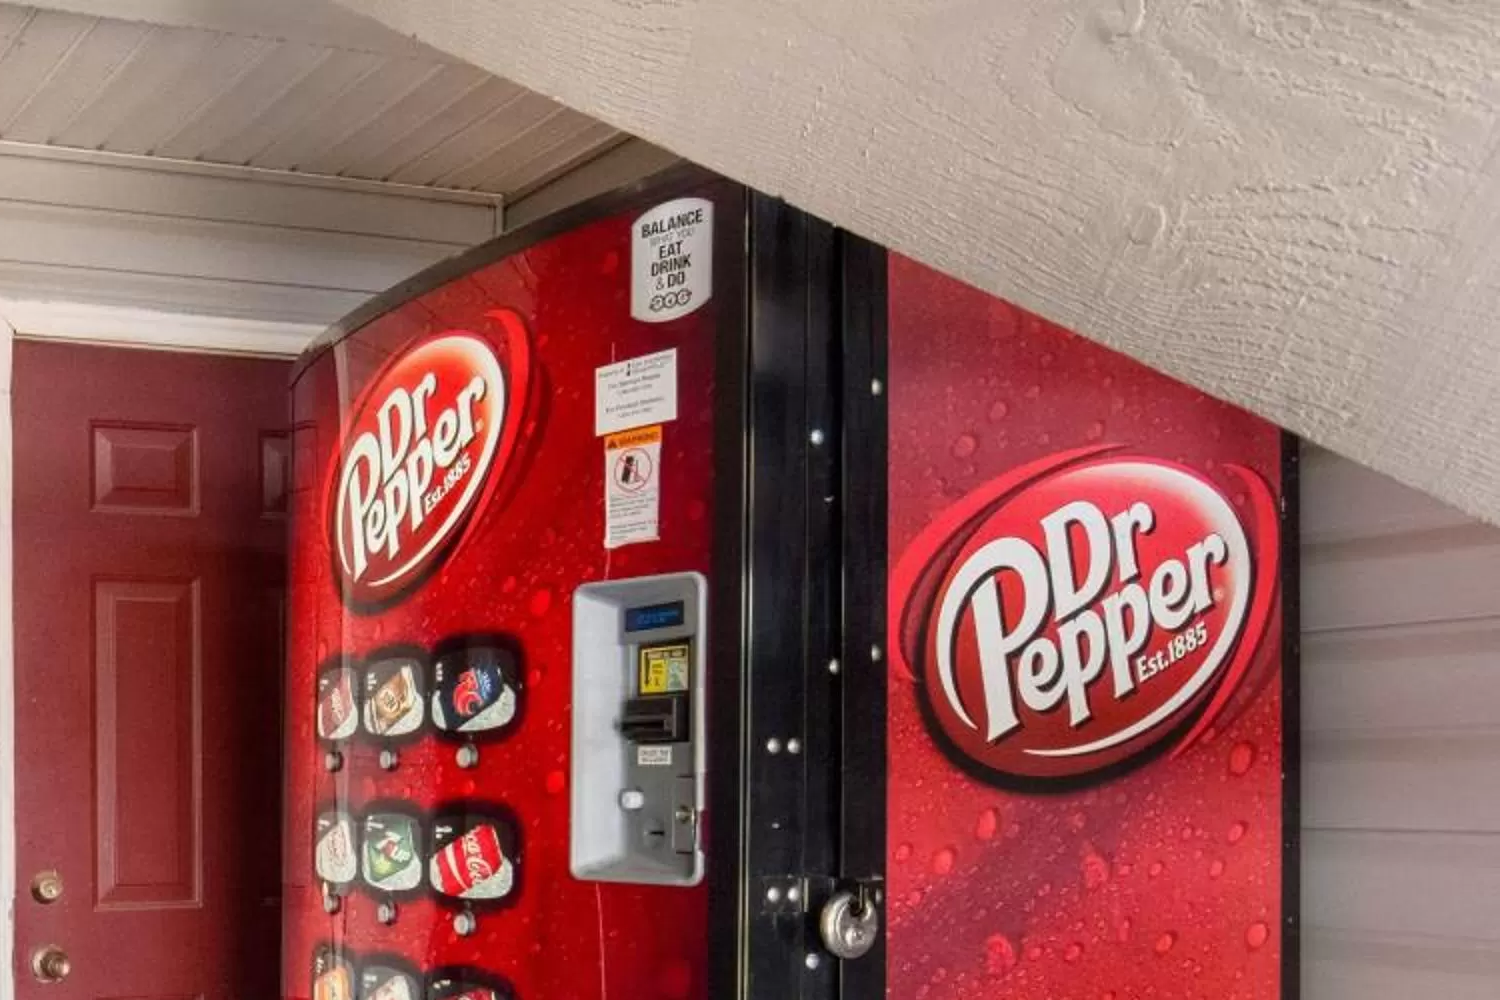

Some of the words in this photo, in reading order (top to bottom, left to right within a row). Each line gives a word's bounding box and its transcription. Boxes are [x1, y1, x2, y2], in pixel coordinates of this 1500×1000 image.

[642, 208, 703, 238] BALANCE
[659, 240, 684, 259] EAT
[651, 254, 691, 277] DRINK
[667, 272, 685, 288] DO
[377, 372, 437, 483] Dr
[338, 376, 487, 583] Pepper
[1041, 500, 1153, 621] Dr
[936, 533, 1226, 742] Pepper
